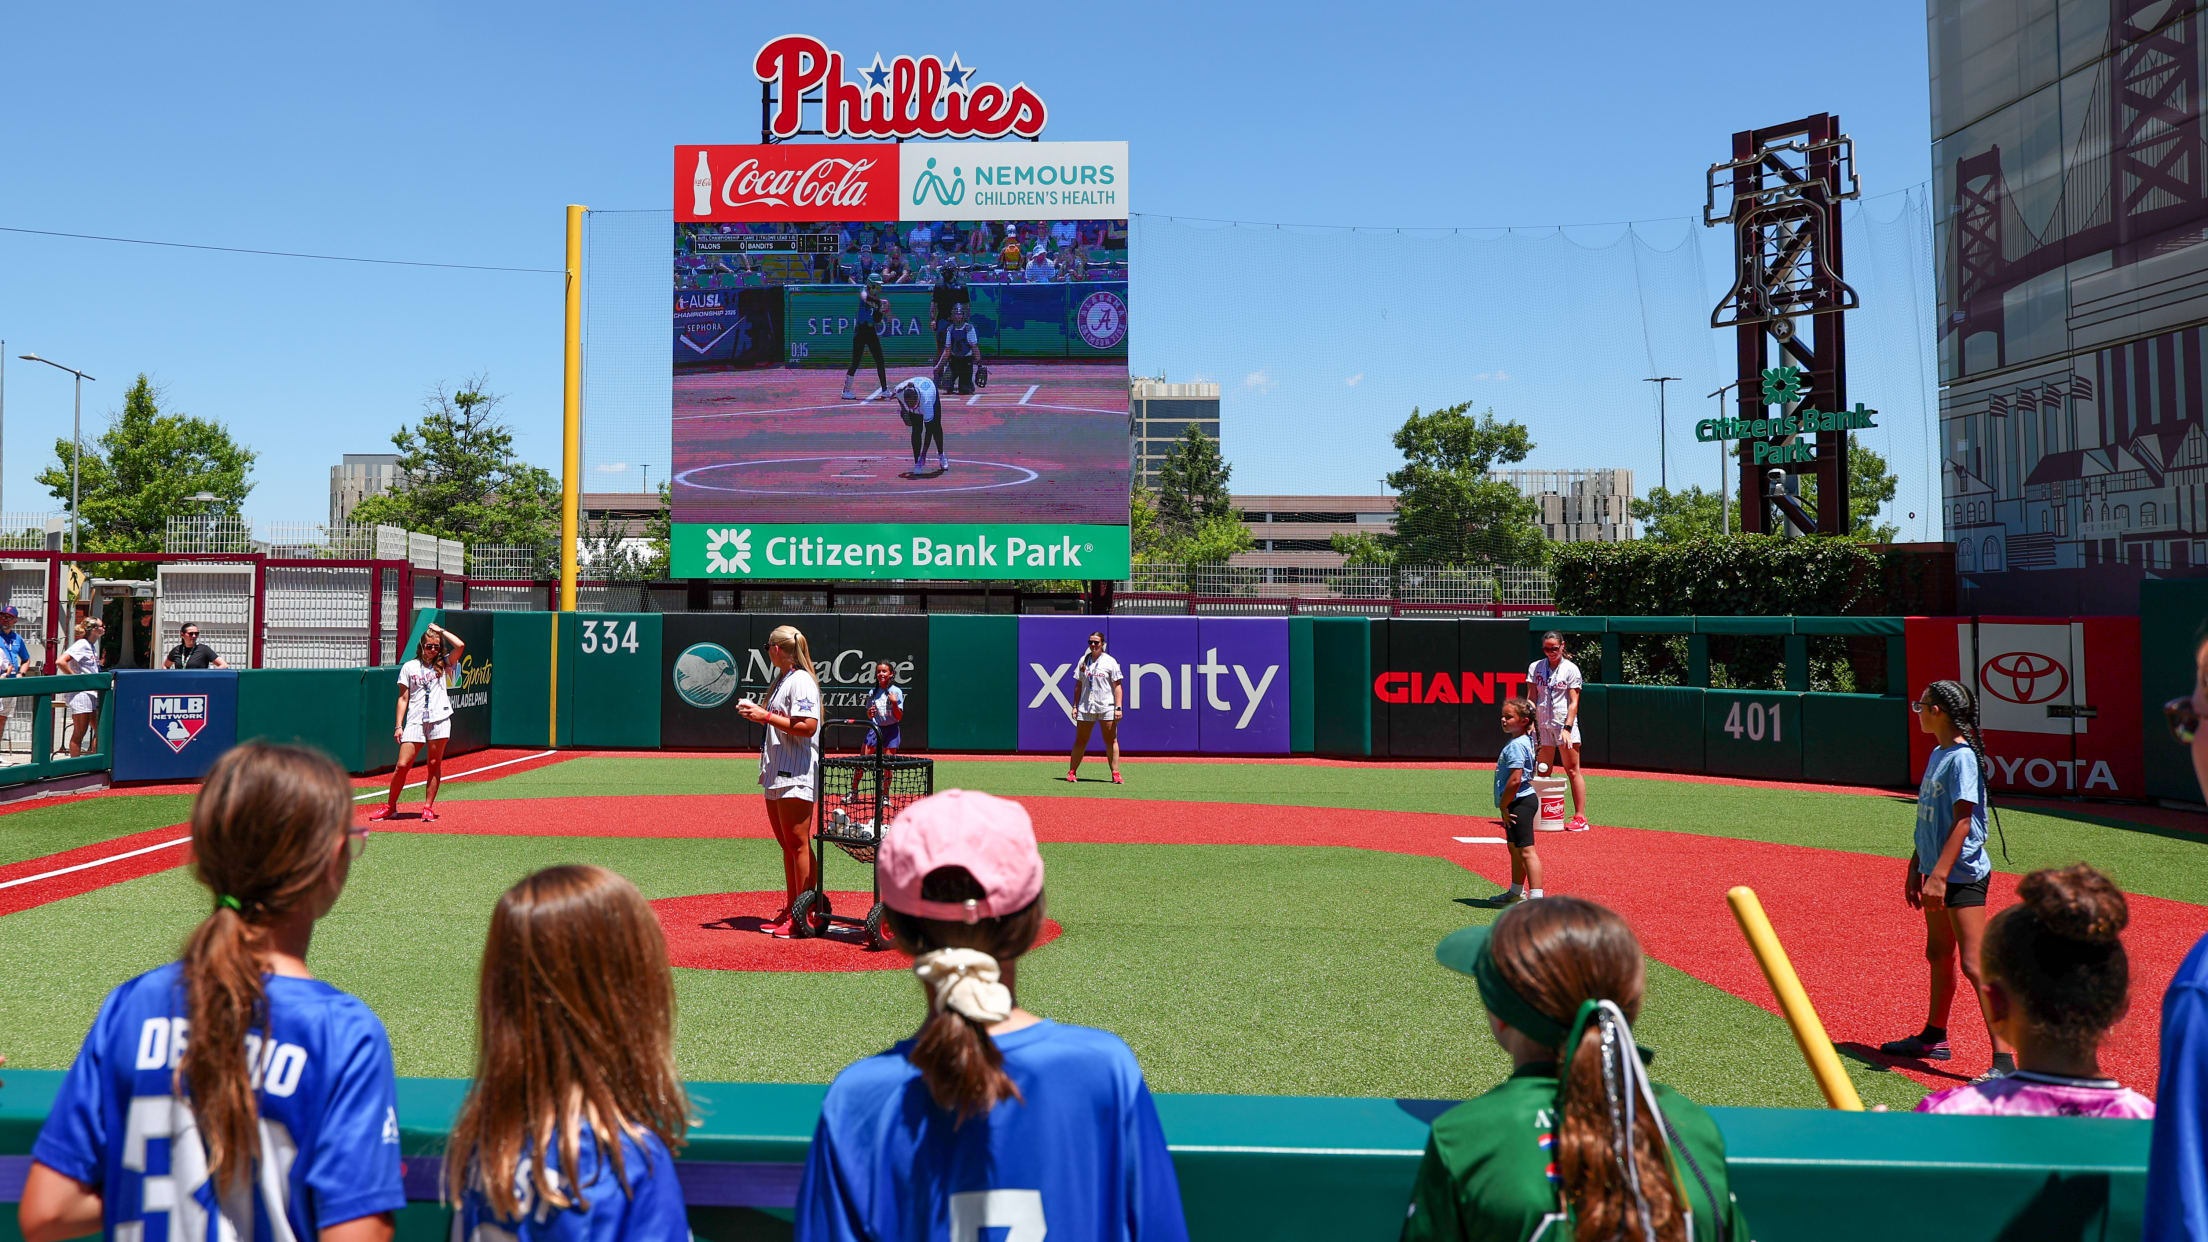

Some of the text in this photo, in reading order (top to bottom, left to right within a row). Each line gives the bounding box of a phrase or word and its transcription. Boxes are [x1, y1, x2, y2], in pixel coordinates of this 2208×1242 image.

[753, 33, 1048, 138] Phillies
[722, 158, 878, 208] Coca-Cola
[975, 165, 1115, 186] NEMOURS
[975, 190, 1115, 206] CHILDREN'S HEALTH
[740, 242, 745, 250] 0
[791, 242, 796, 250] 0
[690, 294, 721, 309] AUSL
[687, 323, 722, 332] SEPHORA
[1695, 403, 1876, 442] Citizens Bank
[1753, 437, 1815, 465] Park
[766, 536, 903, 566] Citizens
[912, 535, 997, 566] Bank
[581, 620, 639, 654] 334
[461, 654, 493, 693] Sports
[1028, 643, 1279, 730] xnity
[1374, 671, 1526, 705] GIANT
[153, 698, 204, 714] MLB
[1724, 702, 1781, 743] 401
